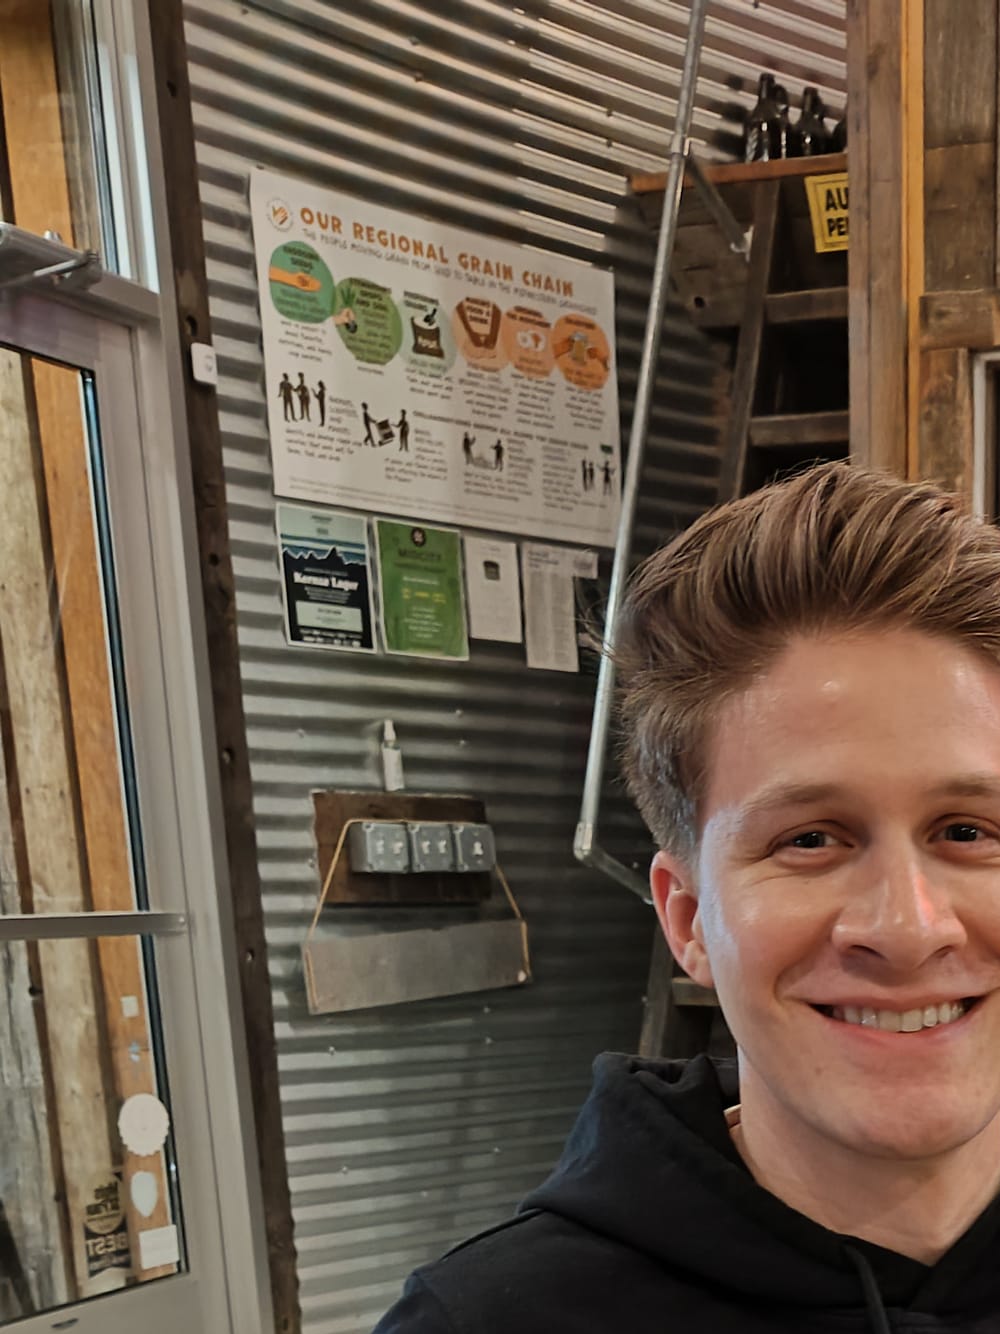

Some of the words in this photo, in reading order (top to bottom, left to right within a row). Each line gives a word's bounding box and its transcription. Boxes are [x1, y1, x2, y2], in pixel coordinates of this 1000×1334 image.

[300, 207, 342, 234] OUR
[352, 222, 449, 264] REGIONAL
[458, 252, 513, 281] GRAIN
[522, 270, 574, 297] CHAIN
[827, 216, 849, 237] PE
